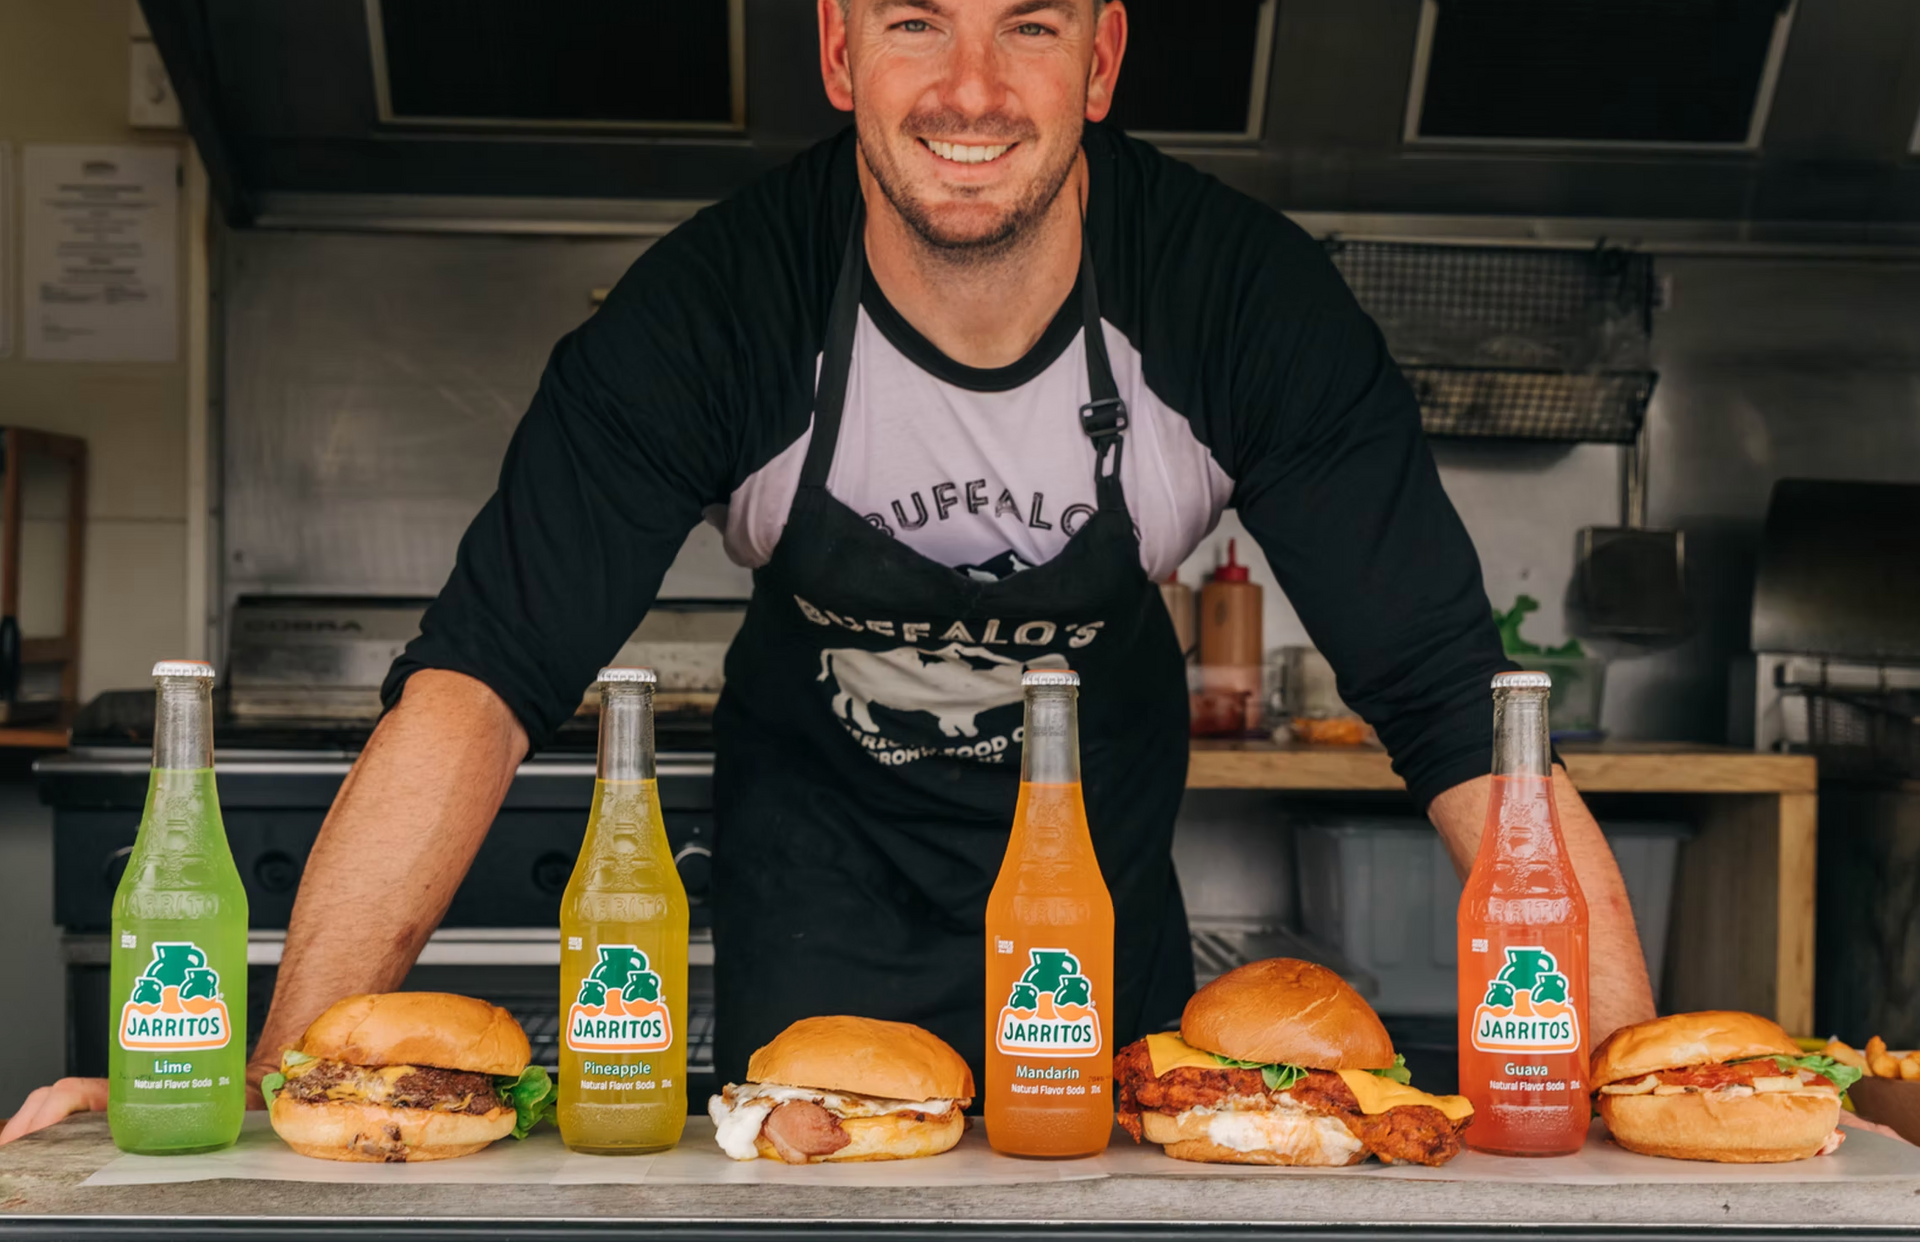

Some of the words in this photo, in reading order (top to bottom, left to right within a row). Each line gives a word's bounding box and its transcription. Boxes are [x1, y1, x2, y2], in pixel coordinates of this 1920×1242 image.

[127, 1016, 220, 1037] JARRITOS
[573, 1019, 662, 1039] JARRITOS
[1004, 1021, 1092, 1043] JARRITOS
[1480, 1019, 1570, 1040] JARRITOS
[154, 1060, 193, 1074] Lime
[583, 1061, 651, 1078] Pineapple
[1504, 1062, 1549, 1076] Guava
[134, 1078, 163, 1089] Natural
[164, 1078, 190, 1089] Flavor
[192, 1078, 213, 1088] Soda
[580, 1079, 607, 1090] Natural
[609, 1080, 634, 1091] Flavor
[635, 1079, 655, 1090] Soda
[1011, 1083, 1039, 1094] Natural
[1040, 1084, 1065, 1095] Flavor
[1066, 1084, 1086, 1095] Soda
[1489, 1079, 1518, 1091] Natural
[1519, 1080, 1544, 1092] Flavor
[1546, 1080, 1565, 1091] Soda
